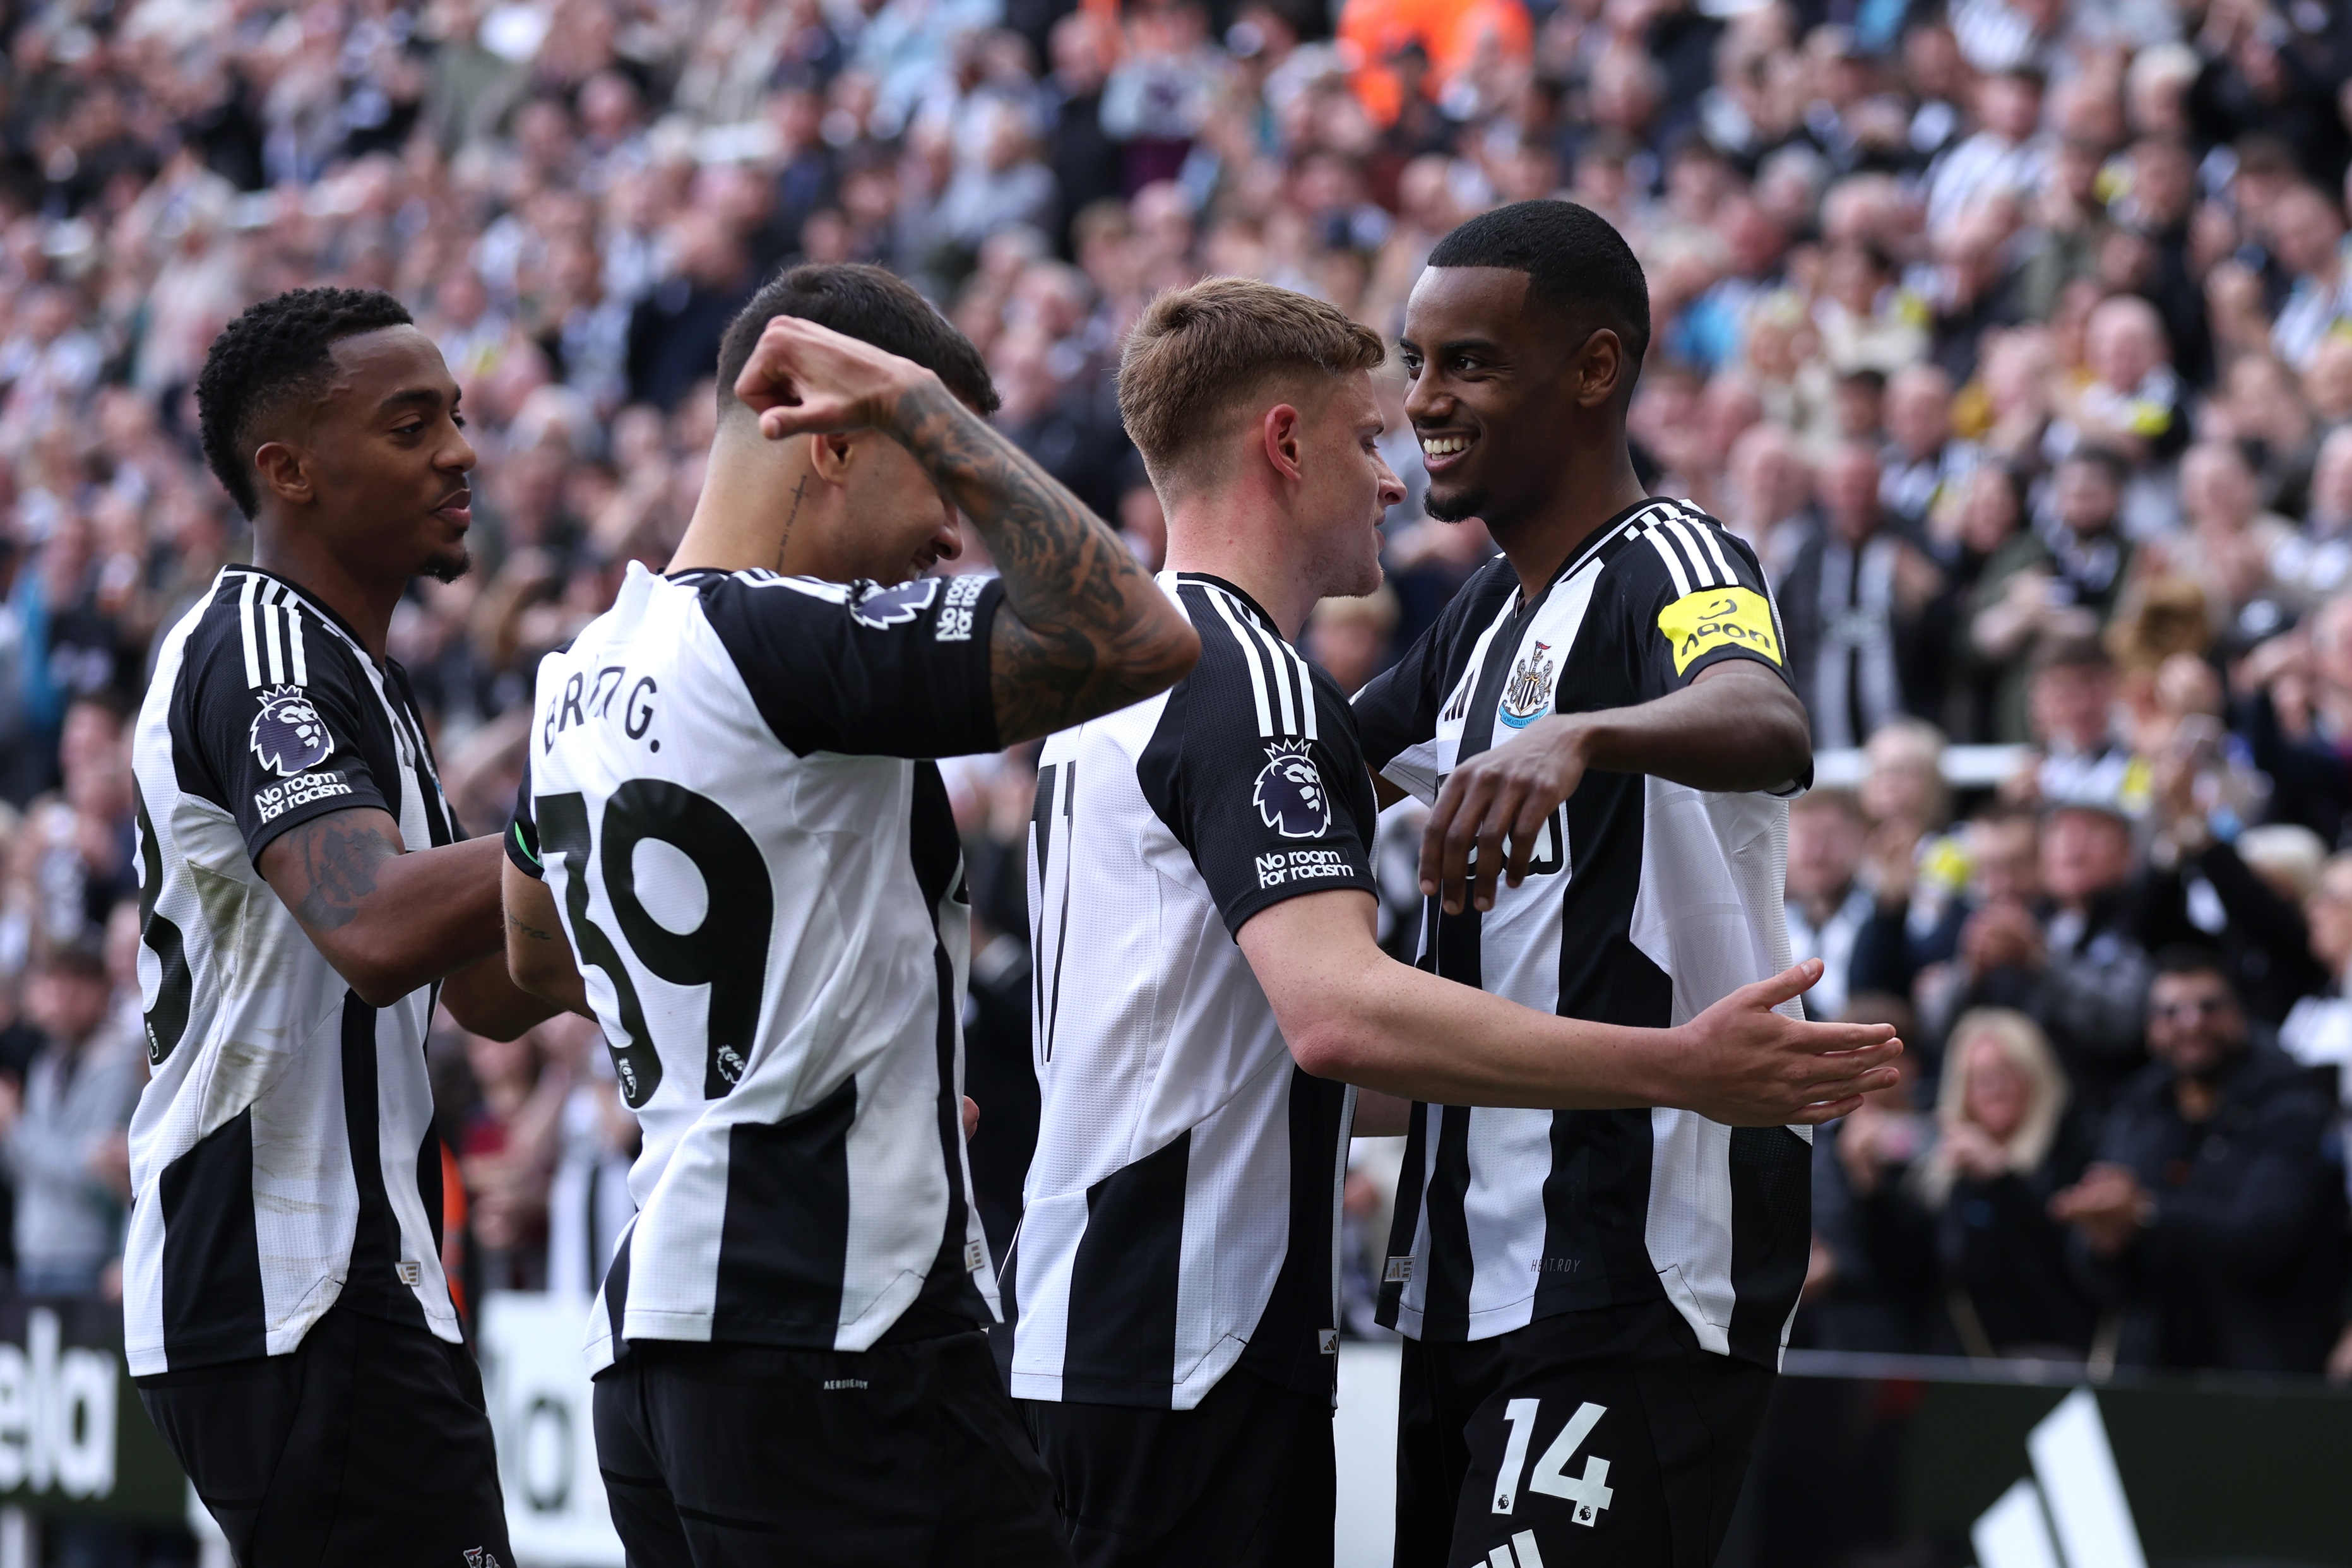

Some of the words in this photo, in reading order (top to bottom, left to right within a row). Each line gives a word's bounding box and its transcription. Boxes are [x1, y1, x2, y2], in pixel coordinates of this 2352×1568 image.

[935, 607, 958, 641] No
[954, 607, 974, 641] for
[1682, 622, 1771, 657] noon
[625, 675, 660, 754] G.
[1502, 715, 1524, 726] NEWCASTLE
[254, 787, 282, 811] No
[283, 772, 338, 795] room
[260, 799, 285, 824] for
[287, 783, 352, 809] racism
[1255, 853, 1285, 875] No
[1288, 850, 1341, 865] room
[1259, 868, 1287, 889] for
[1290, 864, 1355, 880] racism
[1531, 1258, 1581, 1273] HEAT.RDY
[1490, 1397, 1614, 1528] 14
